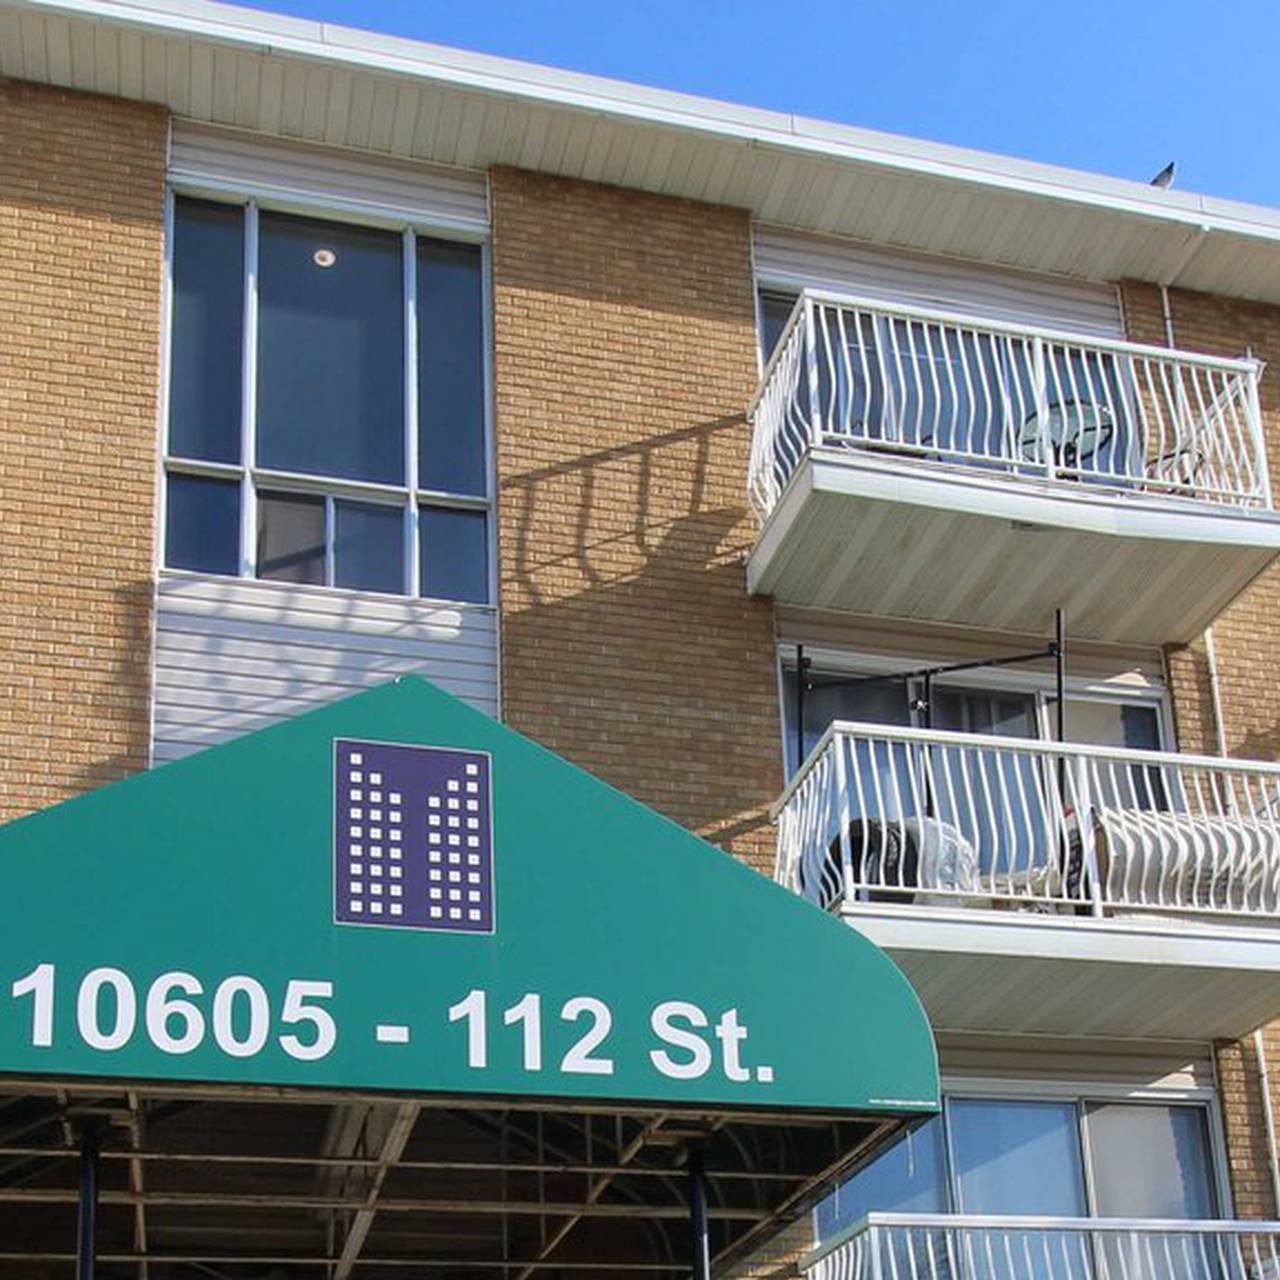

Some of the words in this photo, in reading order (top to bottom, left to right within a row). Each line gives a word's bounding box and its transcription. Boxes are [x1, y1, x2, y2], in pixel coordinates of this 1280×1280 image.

[11, 962, 338, 1062] 10605
[376, 1025, 409, 1043] -
[448, 990, 614, 1076] 112
[648, 1000, 775, 1084] St.
